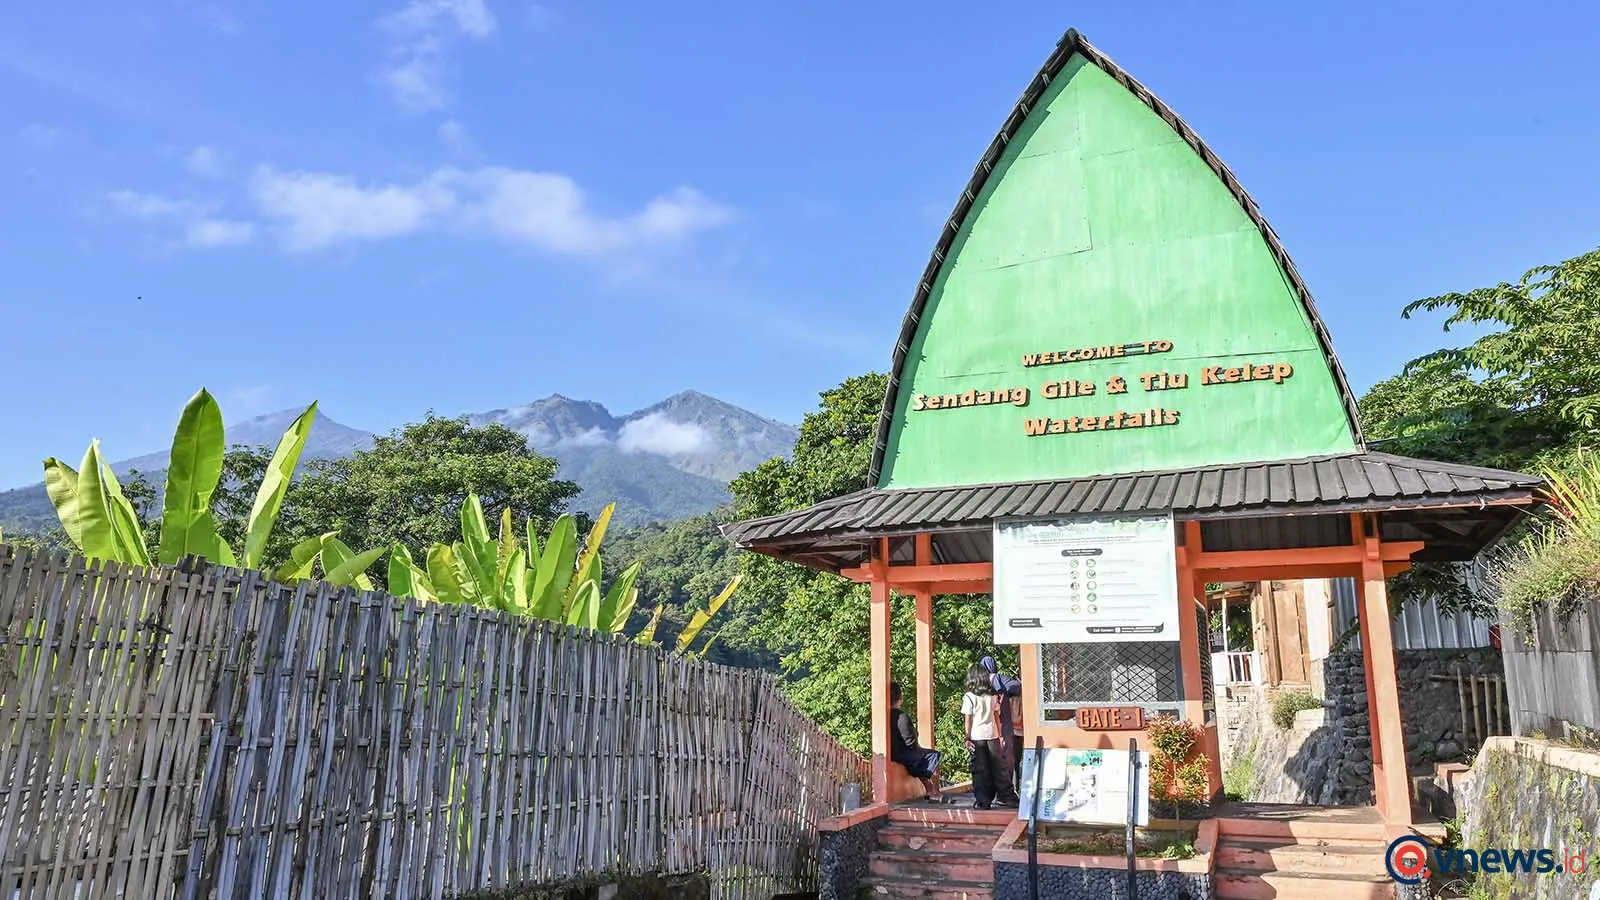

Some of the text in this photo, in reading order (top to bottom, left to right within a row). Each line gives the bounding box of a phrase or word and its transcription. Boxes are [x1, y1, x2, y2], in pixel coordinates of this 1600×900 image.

[1021, 339, 1173, 367] WELCOME TO
[912, 361, 1294, 412] Sendang Gile & Tiu Kelep
[1024, 407, 1181, 437] Waterfalls
[1080, 708, 1121, 728] GATE
[1135, 707, 1143, 728] 1
